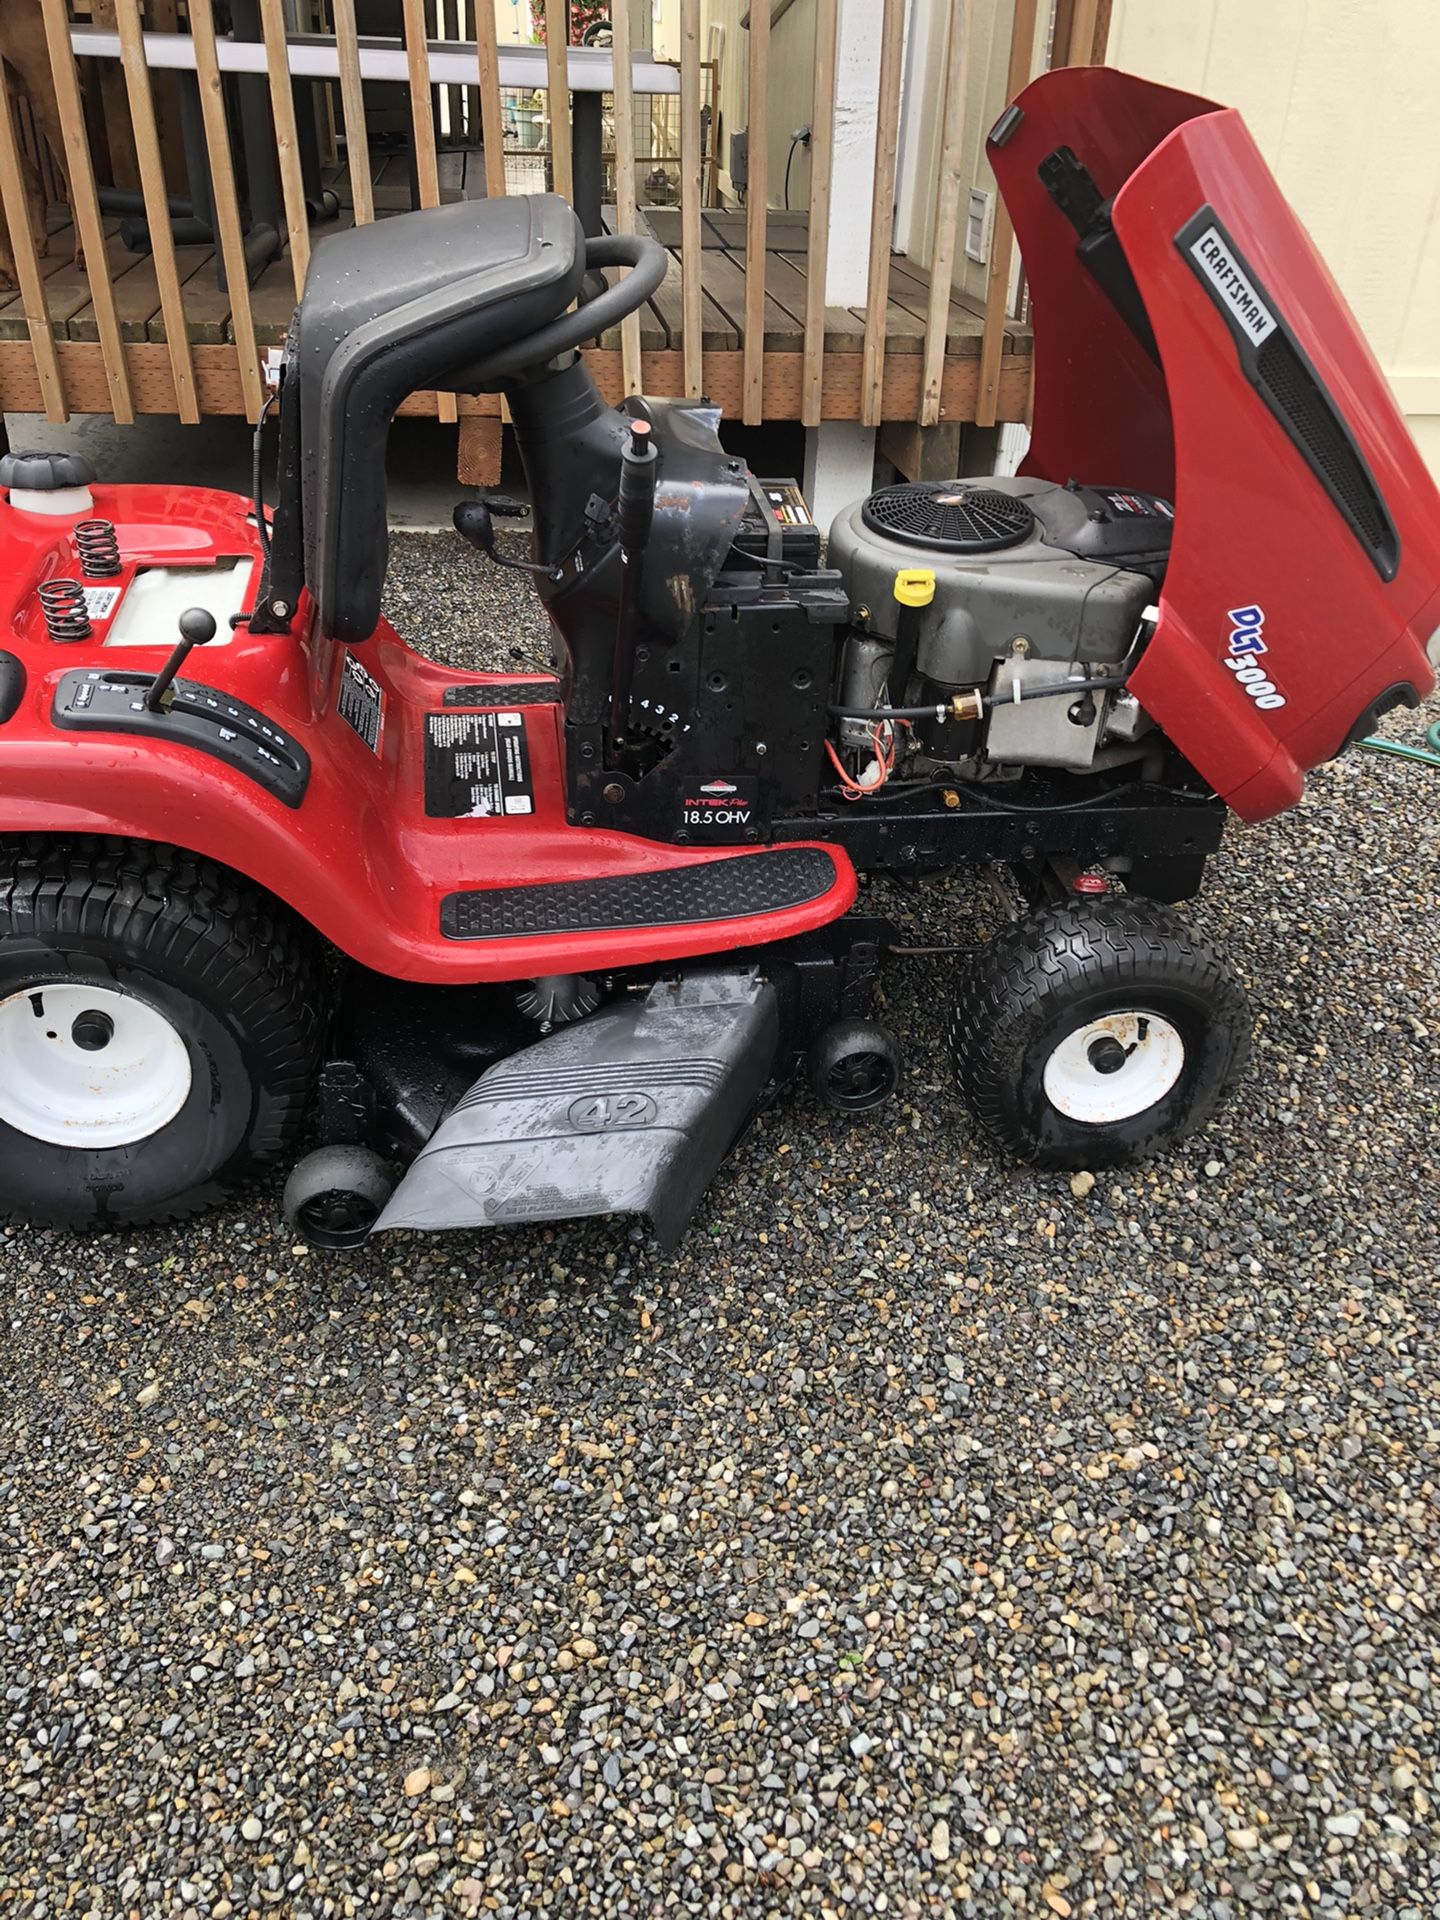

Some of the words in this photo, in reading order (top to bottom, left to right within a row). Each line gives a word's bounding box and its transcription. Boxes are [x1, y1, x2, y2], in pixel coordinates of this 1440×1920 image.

[1200, 237, 1267, 333] CRAFTSMAN
[640, 699, 650, 709] 4
[655, 704, 665, 715] 3
[668, 713, 679, 723] 2
[683, 724, 691, 732] 1
[683, 811, 713, 824] 18.5
[715, 811, 751, 824] OHV
[578, 1096, 649, 1127] 42
